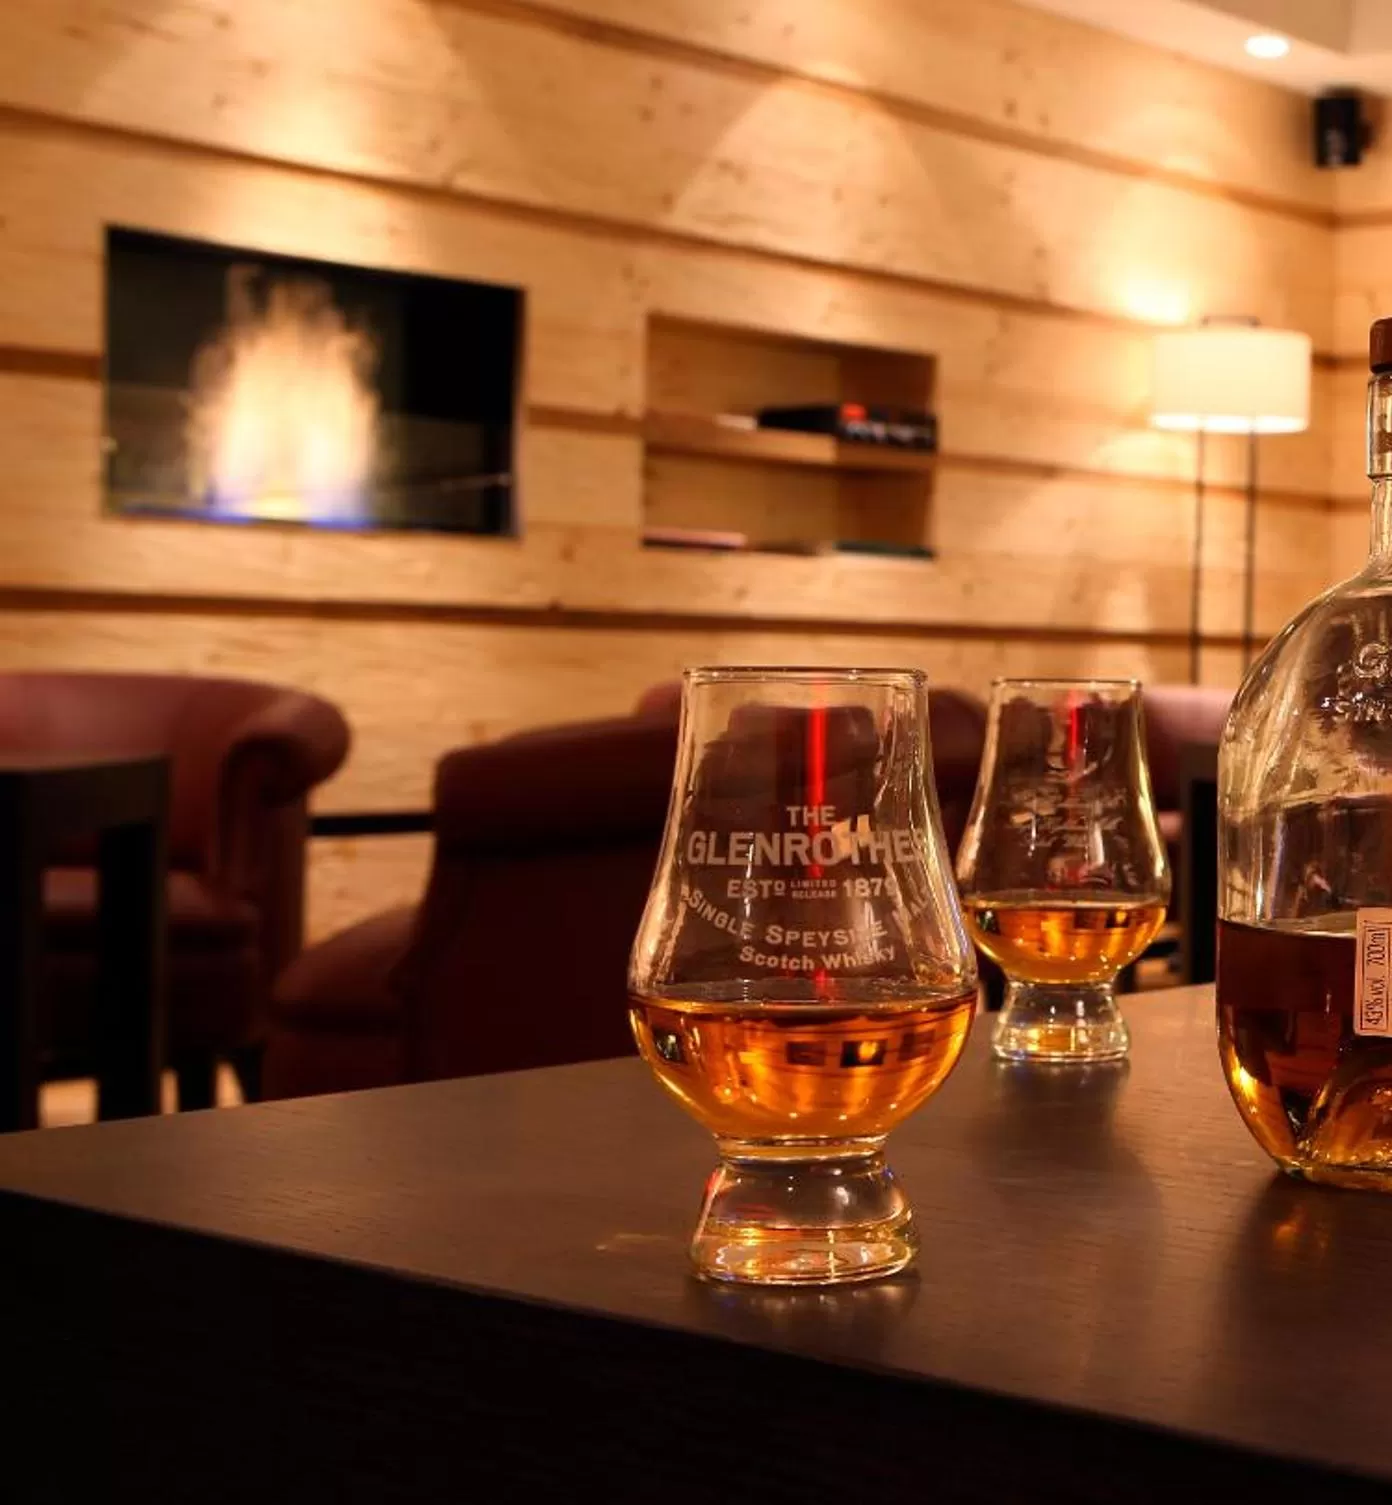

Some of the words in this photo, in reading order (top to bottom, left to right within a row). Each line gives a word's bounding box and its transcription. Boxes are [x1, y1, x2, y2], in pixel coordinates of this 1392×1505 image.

[786, 805, 837, 827] THE
[843, 876, 898, 897] 1879
[688, 887, 756, 939] SINGLE
[739, 945, 815, 971] Scotch
[821, 945, 895, 970] Whisky
